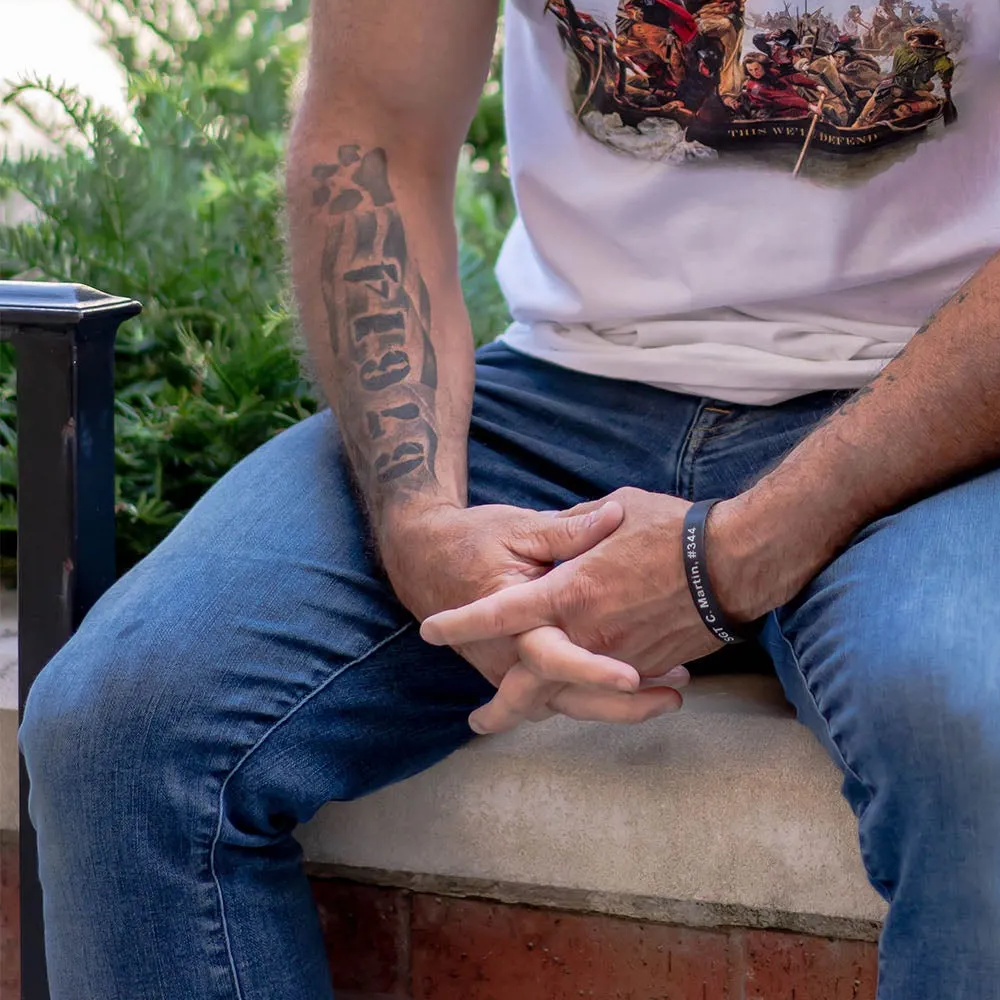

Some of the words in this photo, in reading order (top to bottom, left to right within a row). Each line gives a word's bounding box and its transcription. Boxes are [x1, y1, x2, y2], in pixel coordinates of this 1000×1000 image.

[727, 127, 767, 138] THIS
[772, 127, 816, 138] WE'L
[819, 131, 879, 146] DEFEND
[687, 527, 697, 559] #344
[705, 610, 716, 624] C.
[712, 626, 735, 643] SGT
